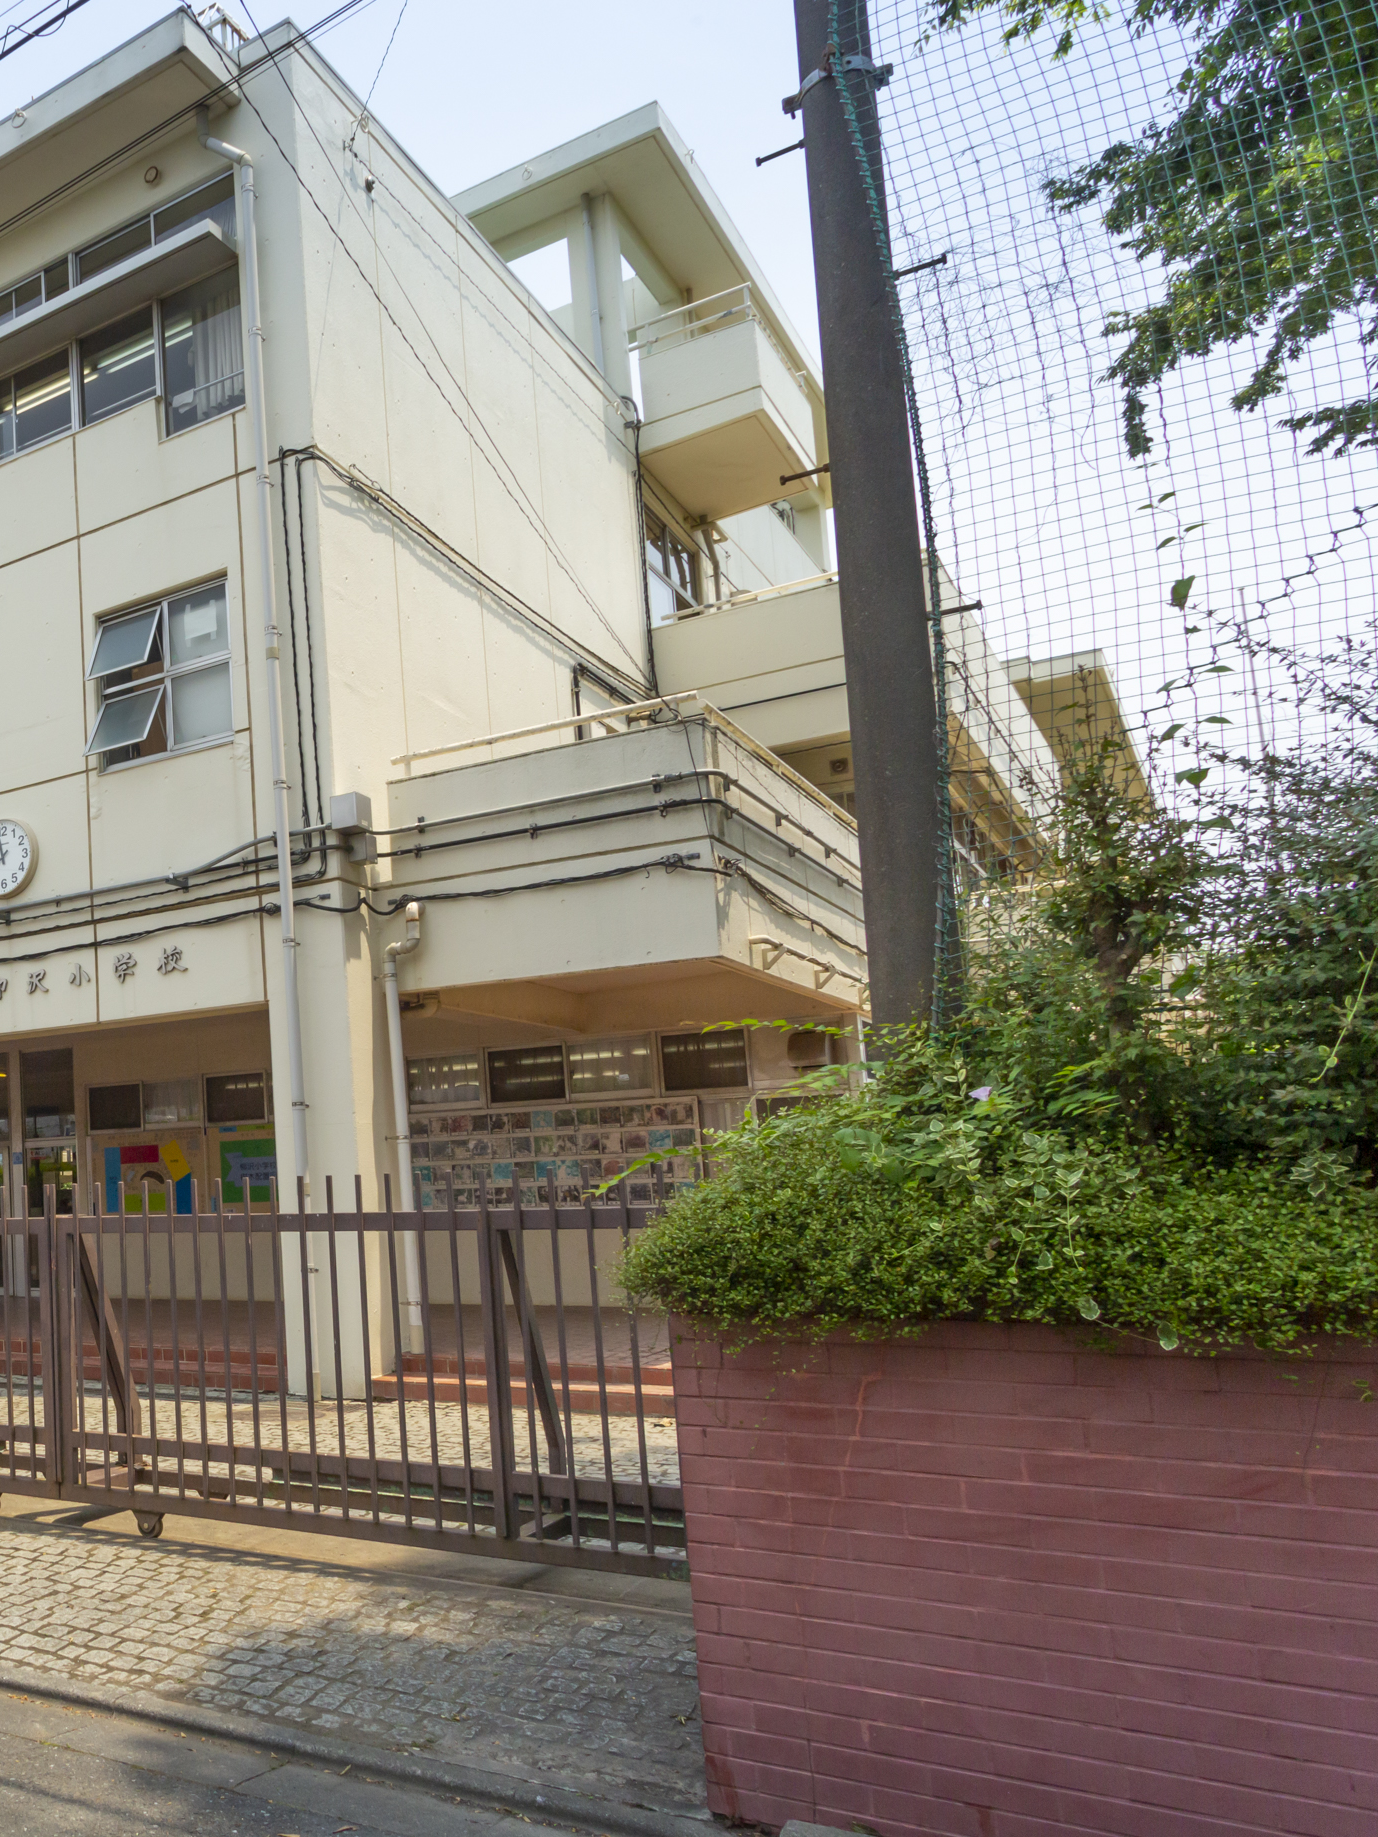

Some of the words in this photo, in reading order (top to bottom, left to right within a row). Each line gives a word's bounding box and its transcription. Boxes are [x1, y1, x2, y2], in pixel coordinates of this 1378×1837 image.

[11, 828, 16, 838] 1
[18, 835, 25, 846] 2
[22, 847, 28, 858] 3
[18, 862, 25, 872] 4
[11, 872, 18, 883] 5
[0, 878, 7, 889] 6
